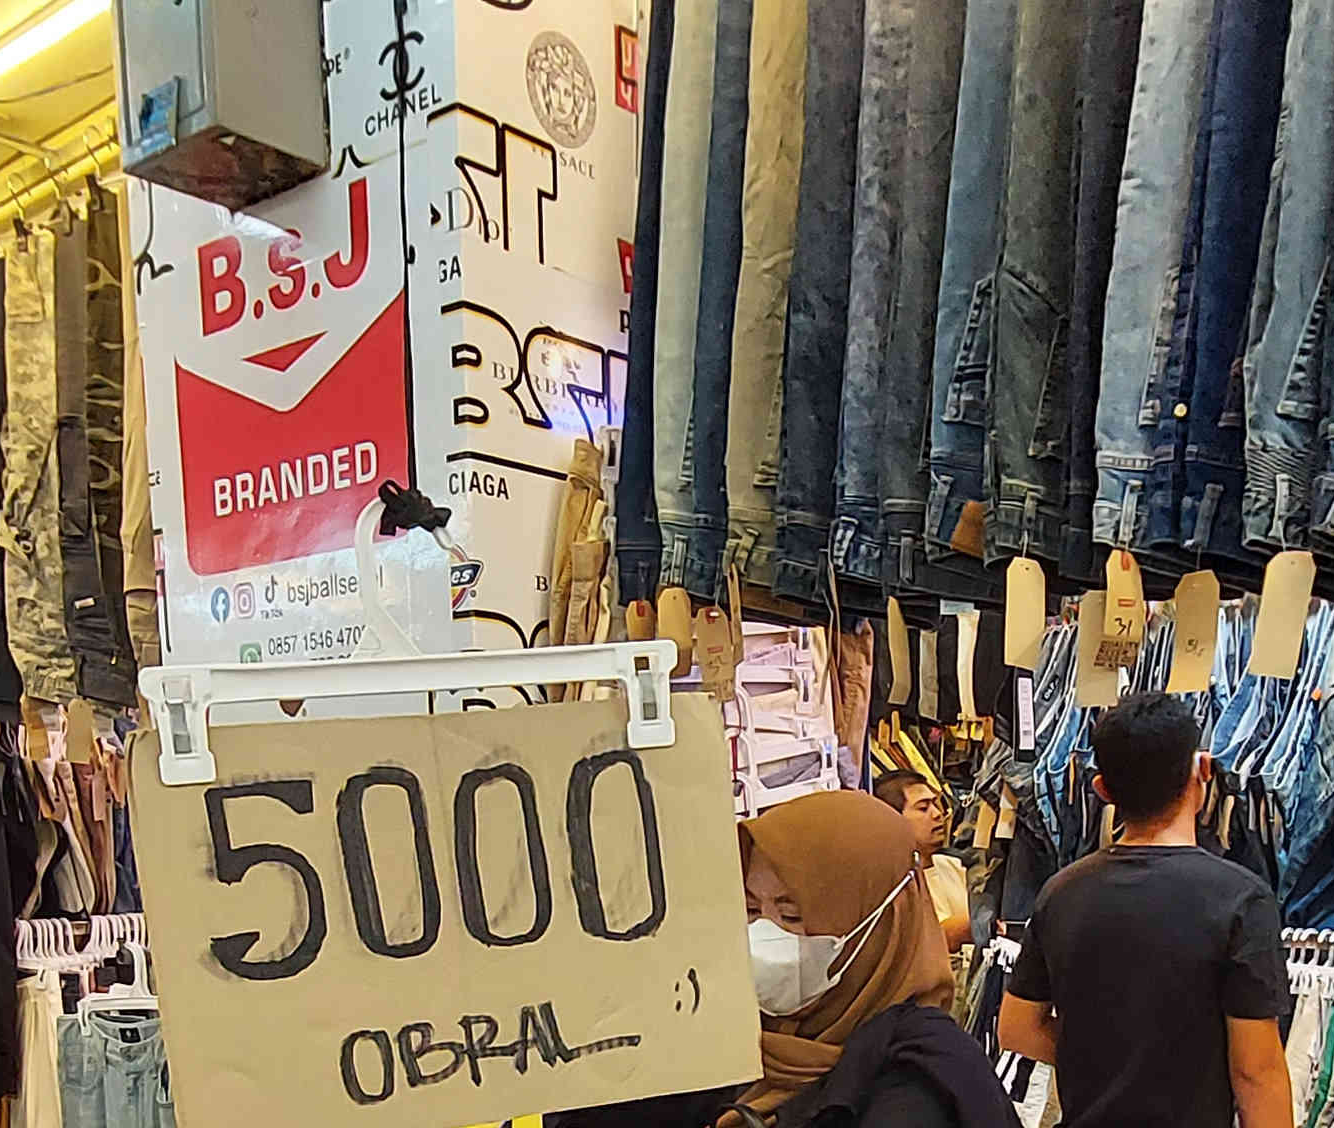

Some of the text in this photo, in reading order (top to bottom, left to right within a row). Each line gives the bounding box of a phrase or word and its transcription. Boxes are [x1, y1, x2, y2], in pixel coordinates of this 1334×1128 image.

[365, 84, 442, 136] CHANEL
[197, 177, 369, 337] B.S.J
[213, 440, 378, 518] BRANDED
[268, 624, 366, 656] 0857 1546 470
[204, 748, 667, 981] 5000
[339, 1001, 641, 1106] OBRAL
